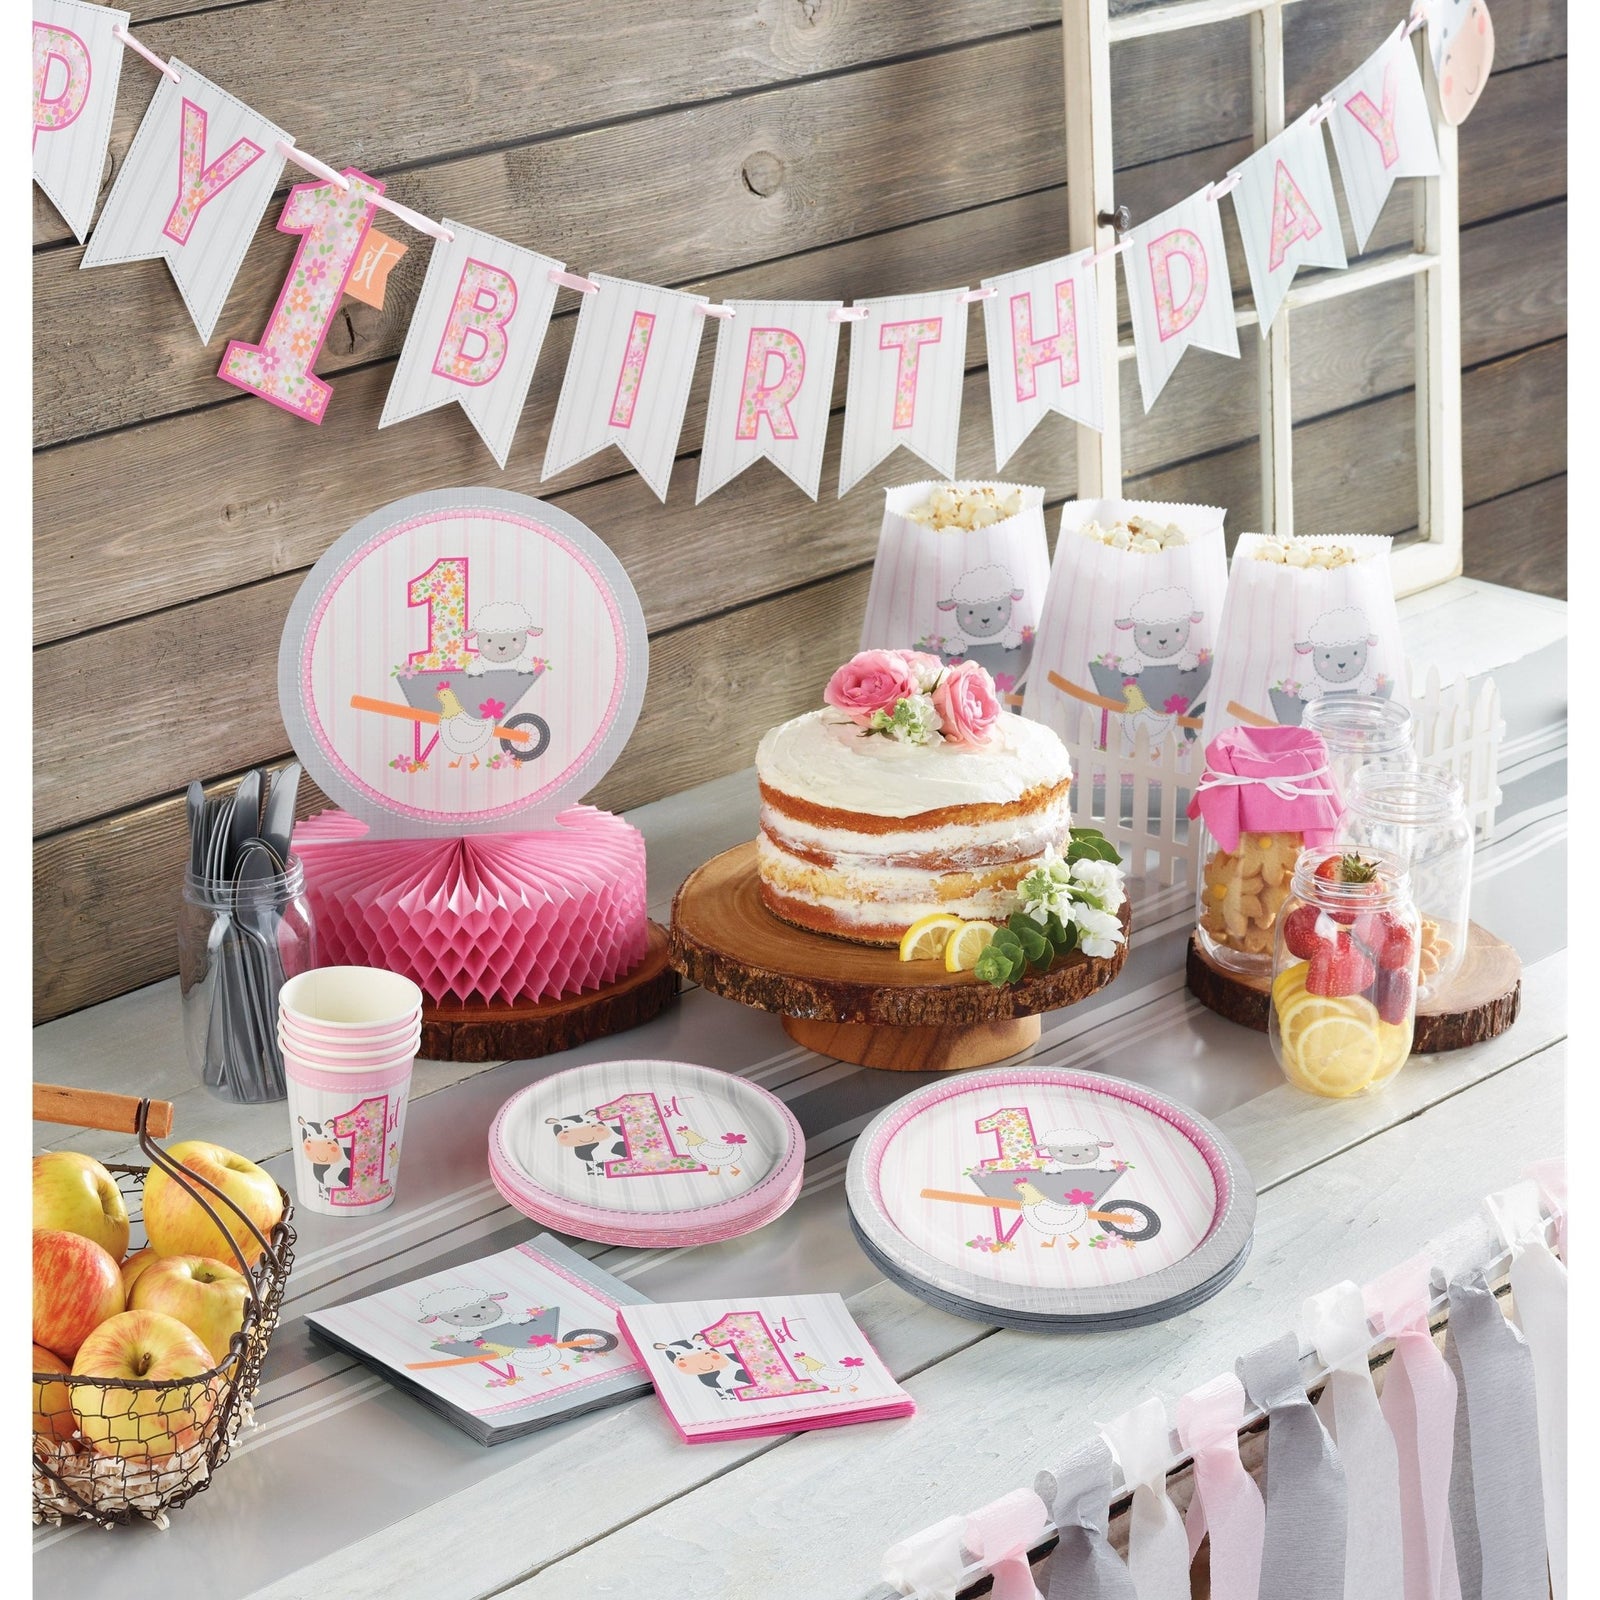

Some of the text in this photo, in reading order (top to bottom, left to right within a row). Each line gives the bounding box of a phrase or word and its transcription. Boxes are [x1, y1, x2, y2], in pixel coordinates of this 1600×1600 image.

[431, 61, 1399, 442] BIRTHDAY
[407, 557, 480, 674] 1
[975, 1107, 1053, 1172] 1
